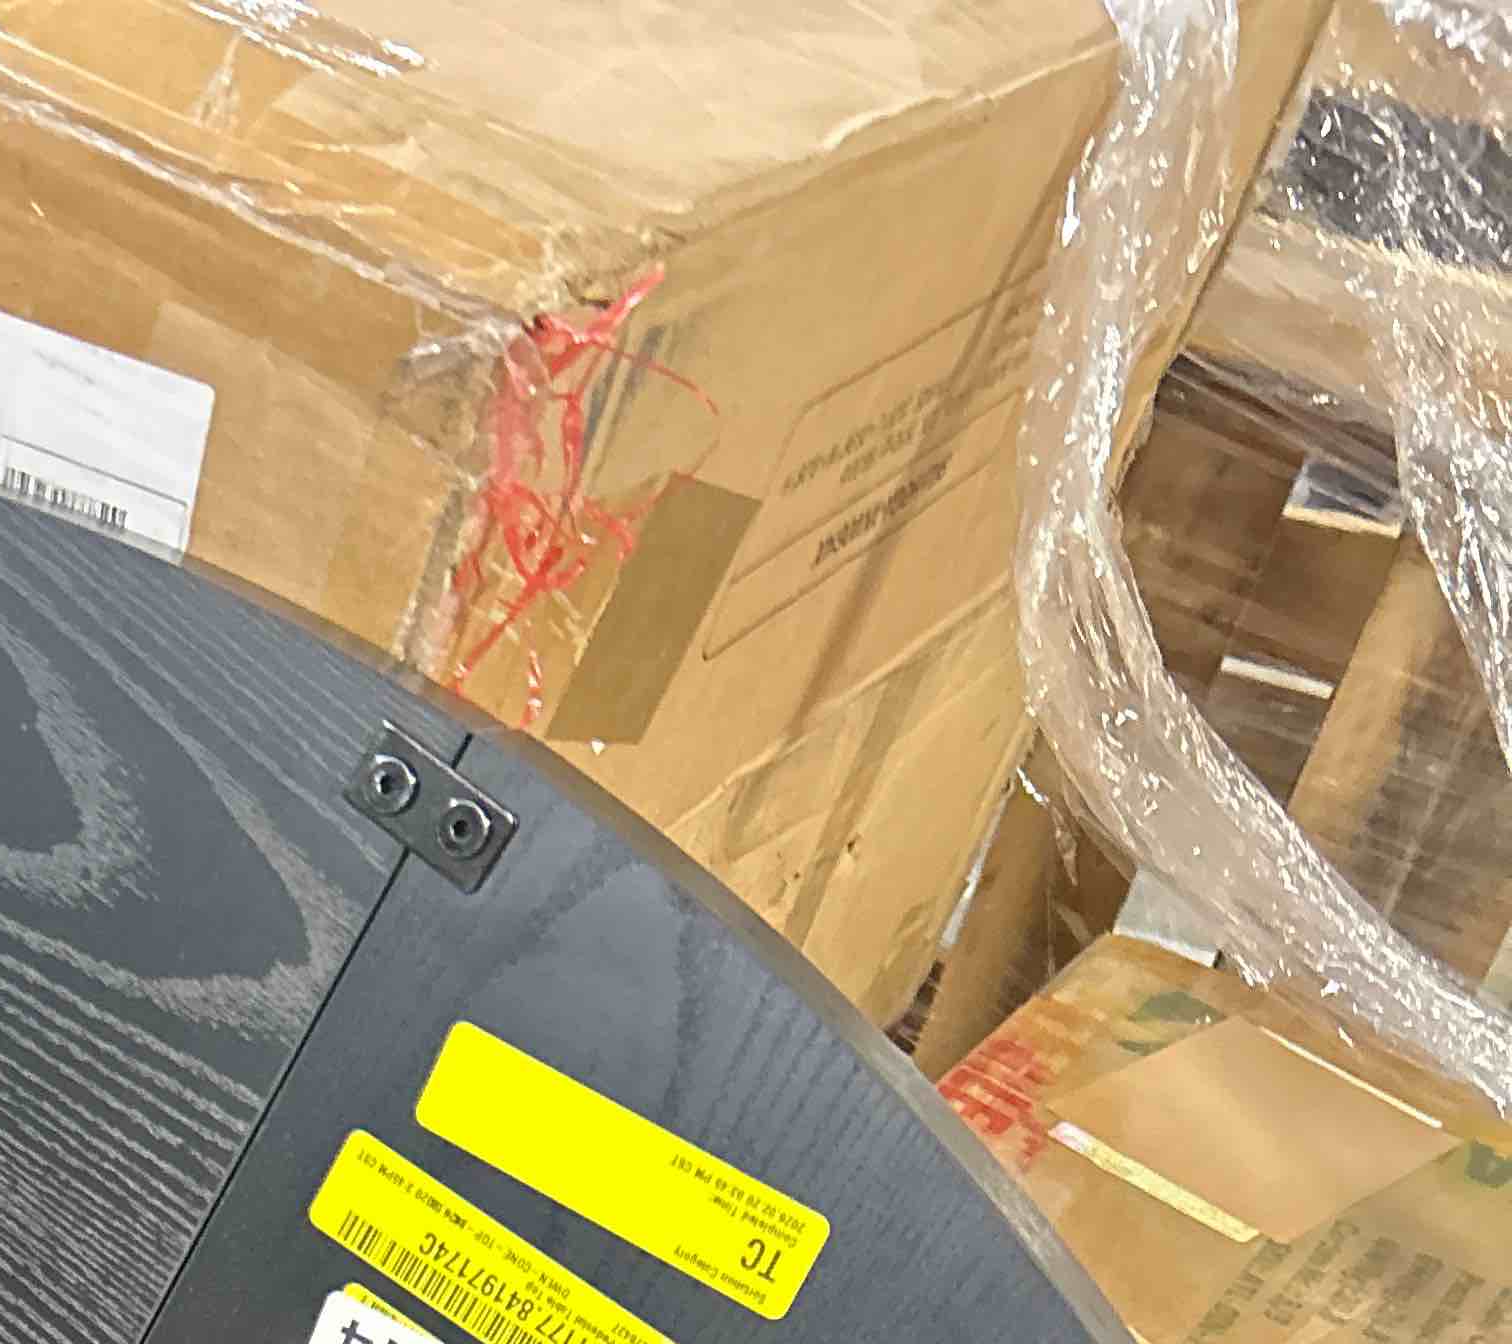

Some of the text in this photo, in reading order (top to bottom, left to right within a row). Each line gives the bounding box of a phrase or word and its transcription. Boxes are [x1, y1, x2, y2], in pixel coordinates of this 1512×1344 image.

[671, 1154, 692, 1173] CST
[695, 1168, 712, 1183] PM
[741, 1239, 781, 1283] TC
[525, 1281, 543, 1300] Top
[547, 1296, 572, 1320] Table
